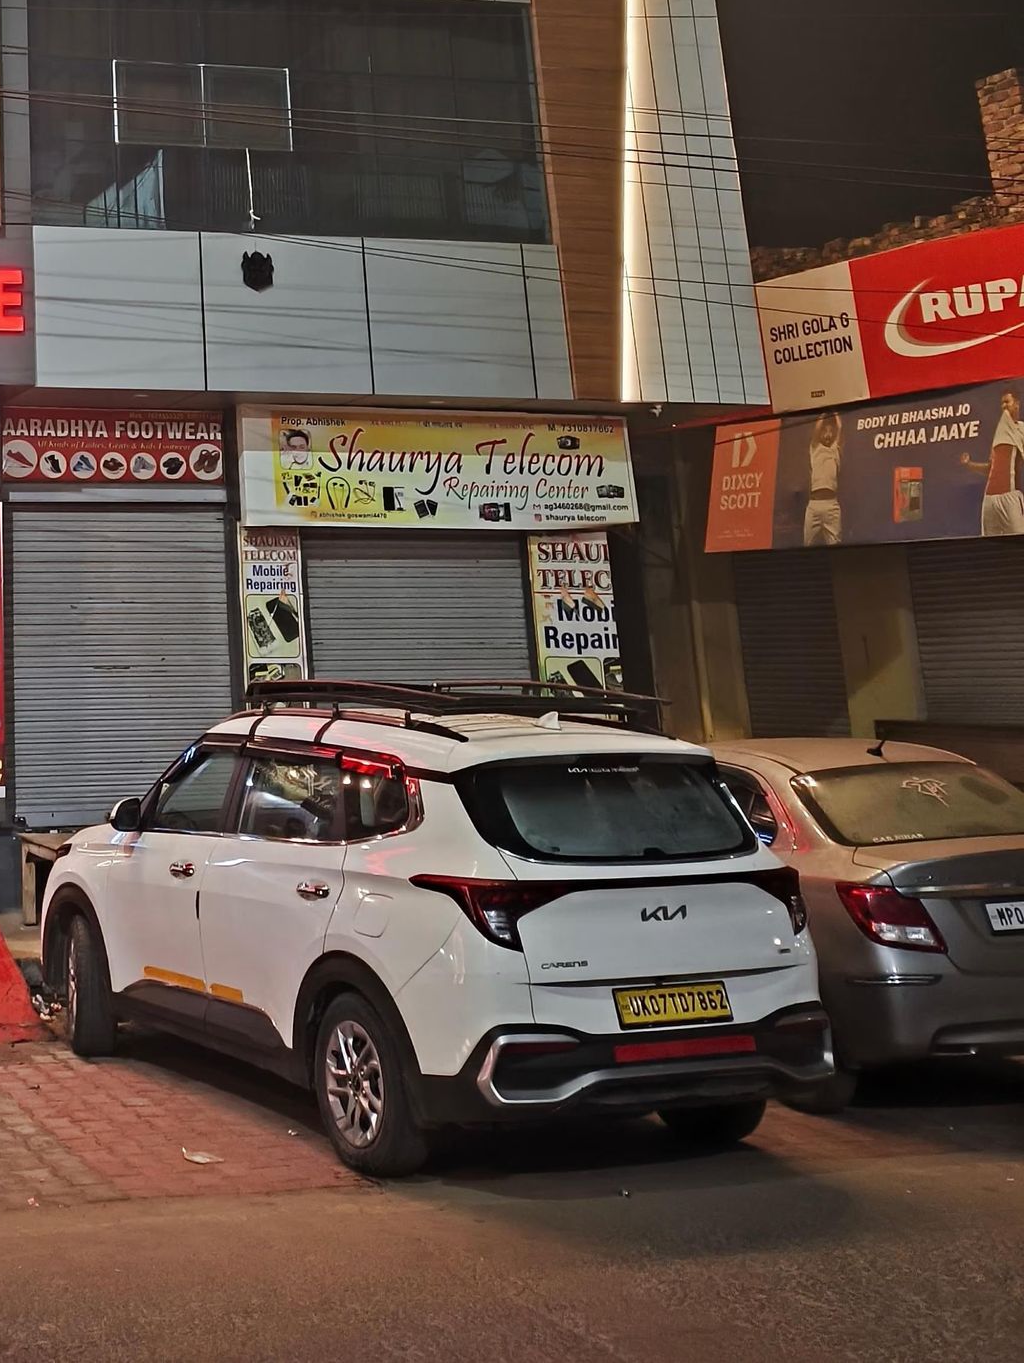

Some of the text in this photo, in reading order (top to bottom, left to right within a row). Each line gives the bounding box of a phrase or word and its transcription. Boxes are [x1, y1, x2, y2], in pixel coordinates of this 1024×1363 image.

[919, 275, 1024, 324] RUP
[769, 322, 800, 343] SHRI
[801, 315, 838, 337] GOLA
[773, 334, 854, 365] COLLECTION
[281, 416, 304, 427] Prop.
[306, 416, 346, 427] Abhishek
[857, 402, 971, 431] BODY KI BHAASHA JO
[2, 417, 223, 441] AARADHYA FOOTWEAR
[873, 421, 981, 450] CHHAA JAAYE
[317, 427, 605, 495] Shaurya Telecom
[721, 471, 764, 491] DIXCY
[442, 476, 589, 511] Repairing Center
[719, 491, 761, 511] SCOTT
[545, 513, 607, 522] shaurya telecom
[243, 549, 297, 562] TELECOM
[252, 564, 290, 577] Mobile
[246, 578, 297, 593] Repairing
[640, 904, 687, 922] KIA
[540, 959, 589, 970] CARENS
[628, 989, 729, 1018] UK07TD7862
